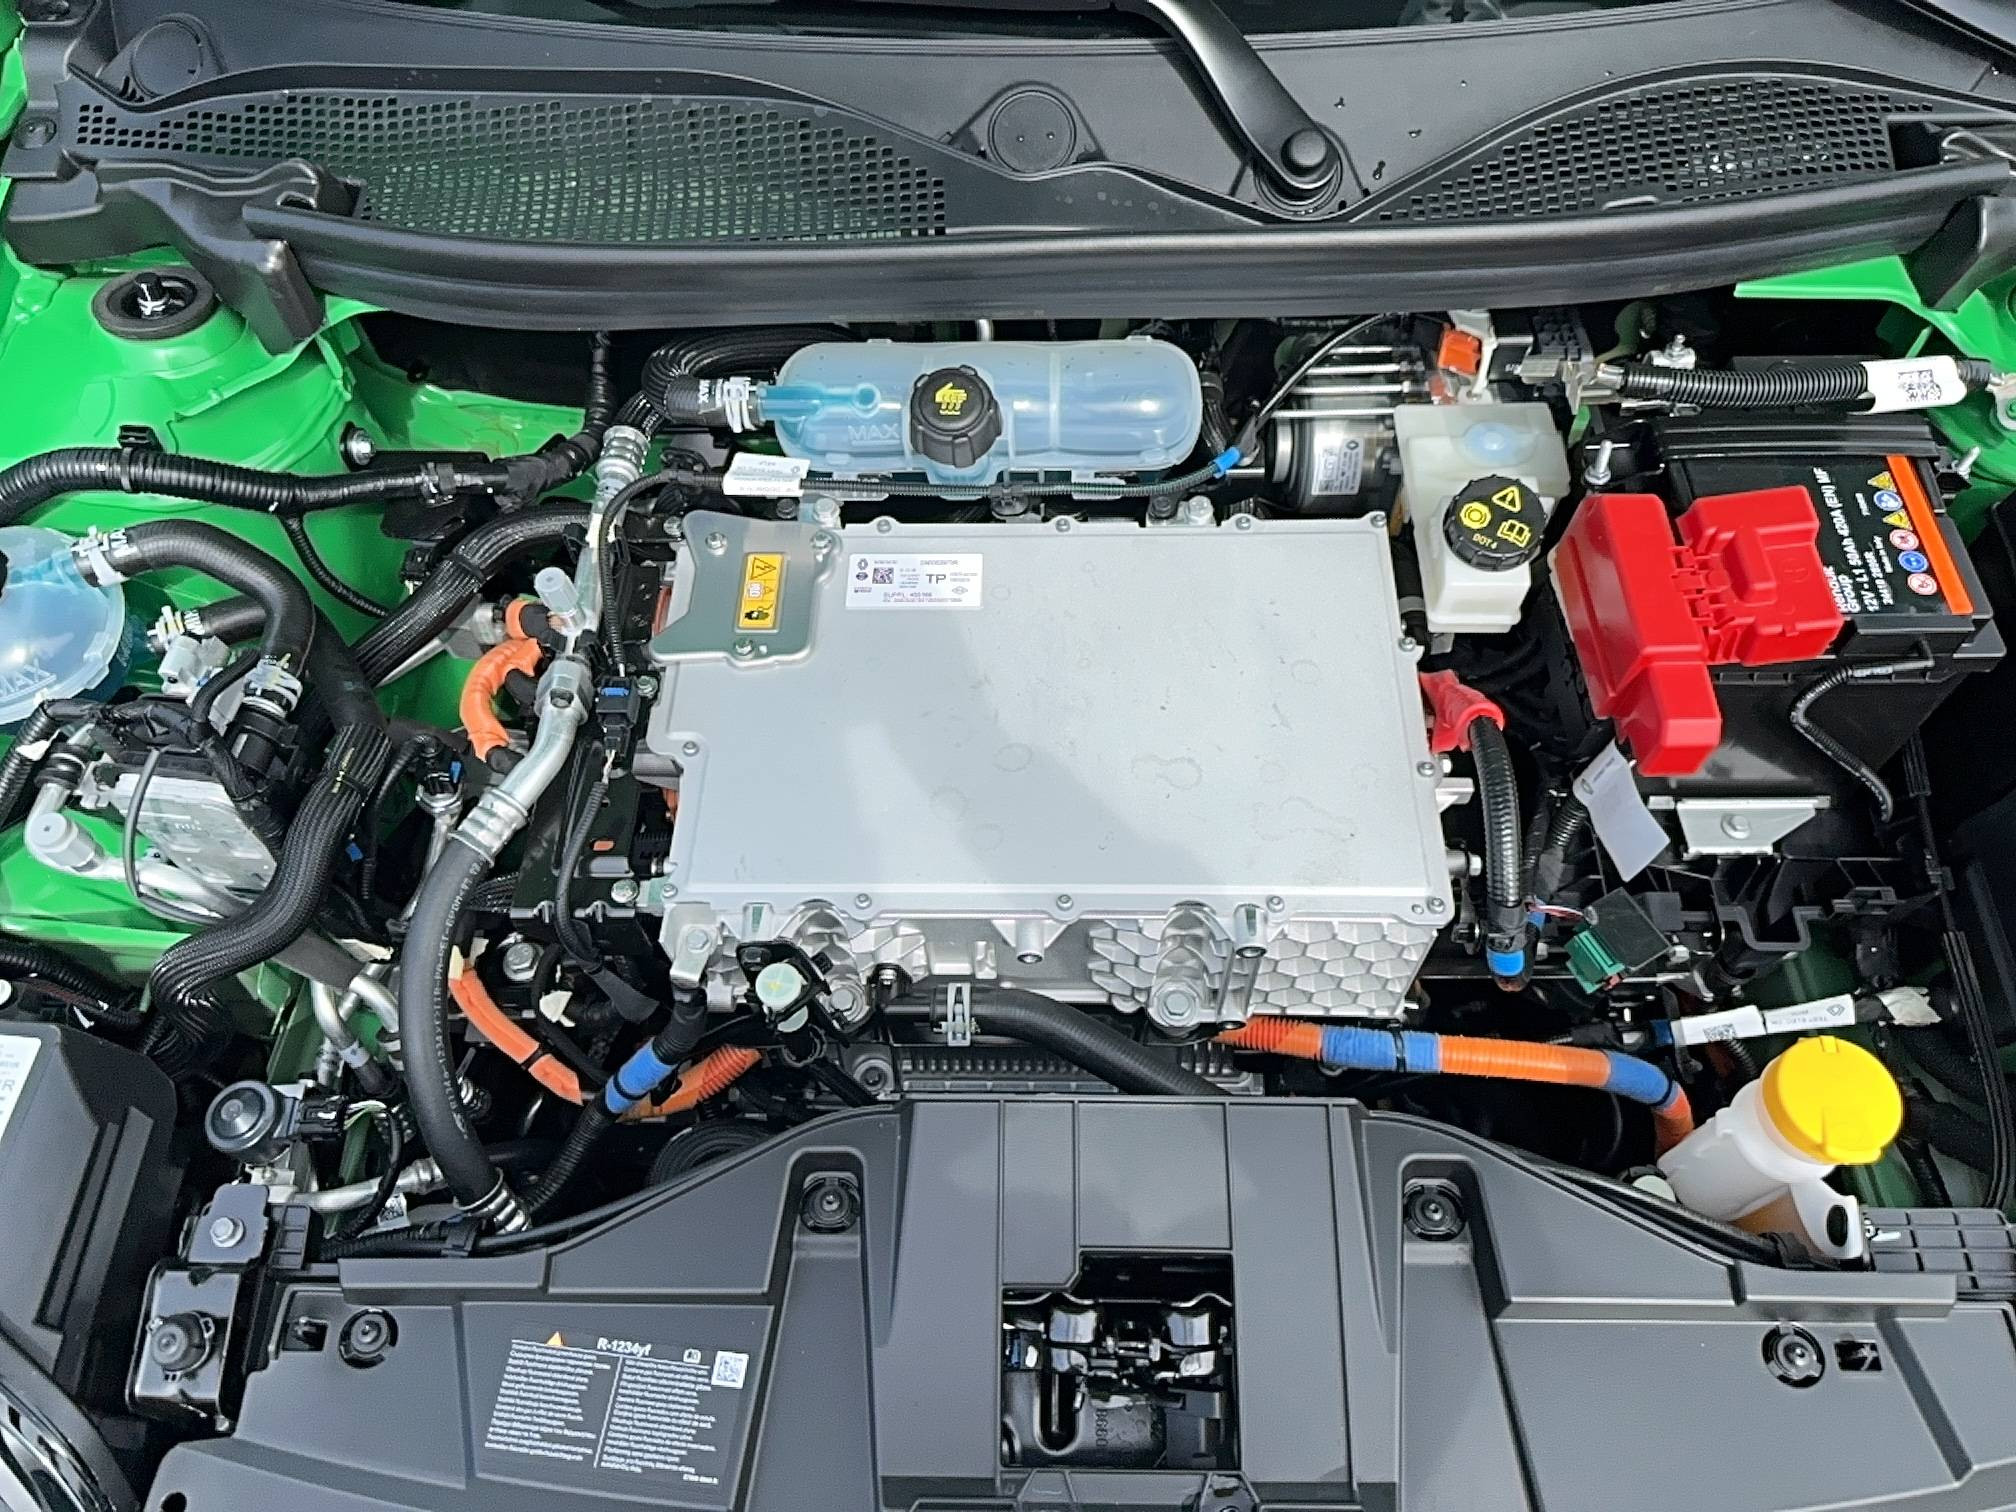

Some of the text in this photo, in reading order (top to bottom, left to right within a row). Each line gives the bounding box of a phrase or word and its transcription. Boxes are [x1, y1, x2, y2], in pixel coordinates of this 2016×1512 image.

[848, 424, 899, 440] MAX
[1813, 467, 1831, 483] MF
[1821, 485, 1843, 508] (EN)
[1830, 508, 1850, 537] 420A
[1841, 537, 1863, 566] 50Ah
[925, 573, 947, 585] TP
[1838, 574, 1861, 613] Group
[1860, 590, 1880, 612] 12V
[597, 1337, 652, 1358] R-1234yf
